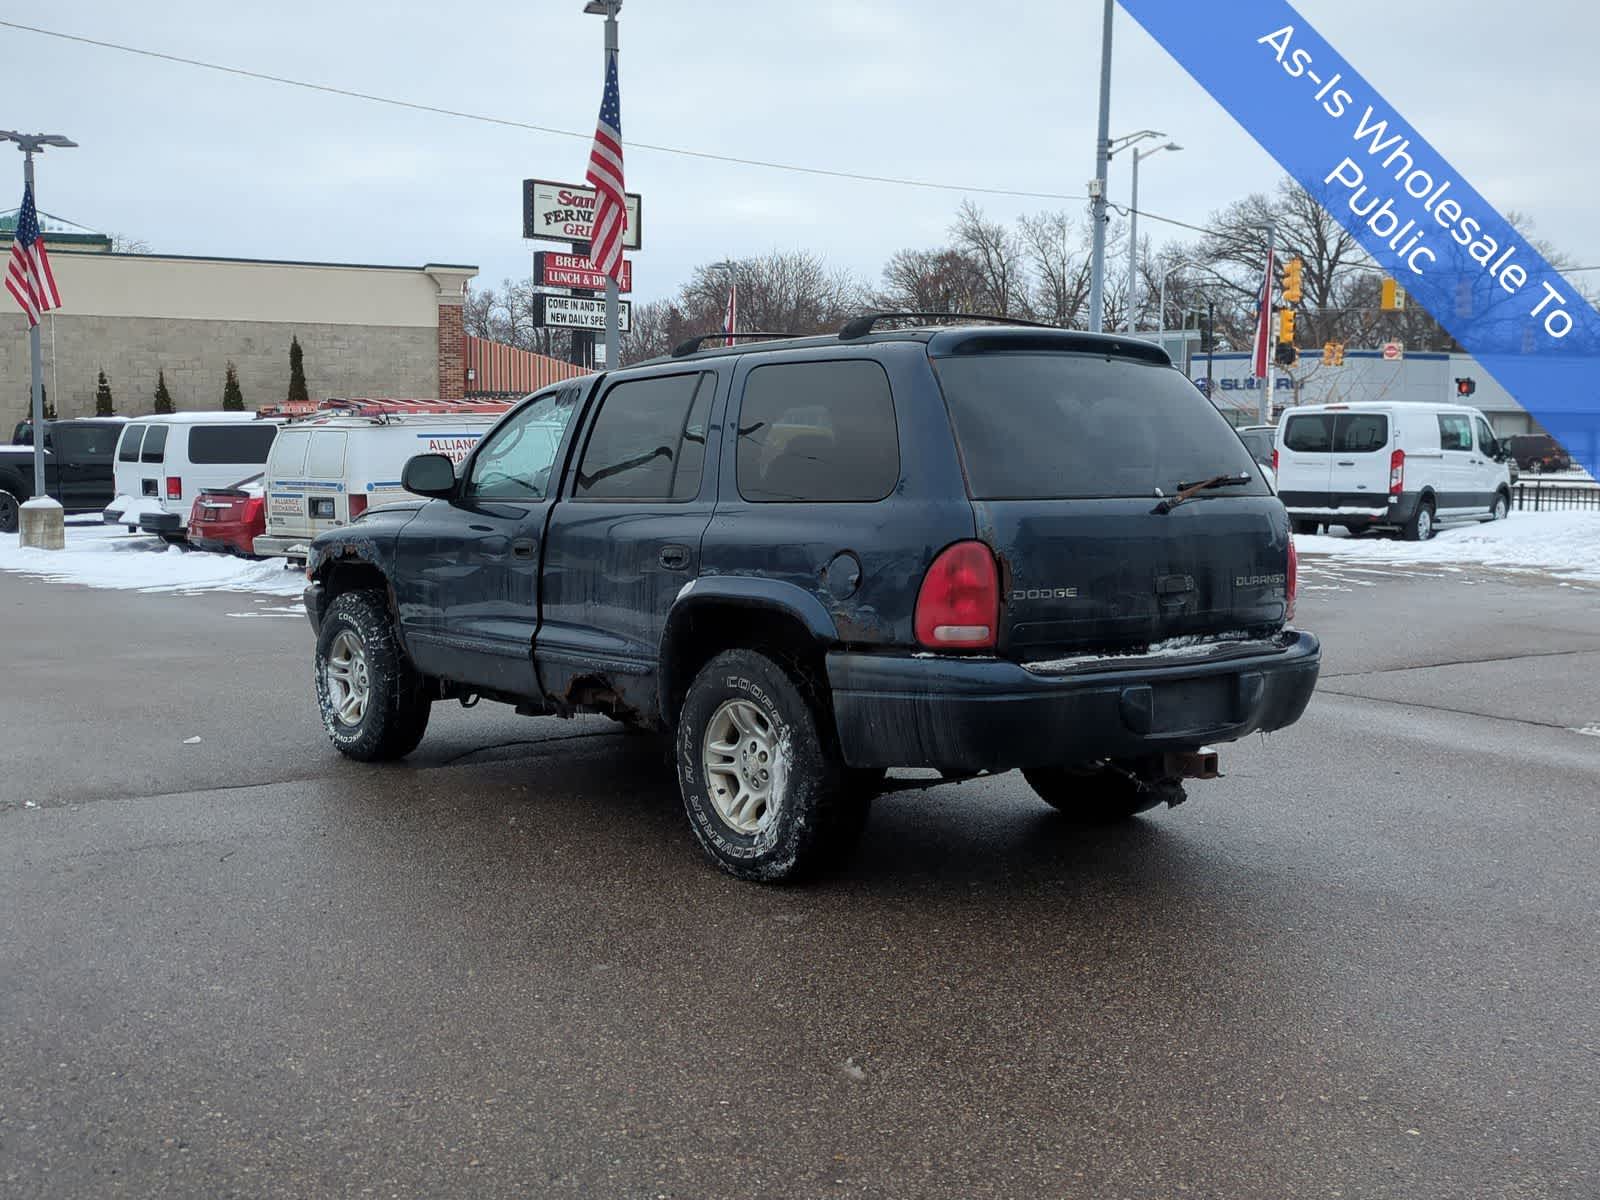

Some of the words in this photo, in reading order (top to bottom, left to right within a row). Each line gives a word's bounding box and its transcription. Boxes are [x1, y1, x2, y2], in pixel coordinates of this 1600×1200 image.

[544, 209, 593, 225] FERND
[563, 223, 592, 237] GRI
[555, 255, 597, 271] BREAK
[549, 271, 580, 285] LUNCH
[583, 275, 590, 286] &
[548, 299, 569, 311] COME
[570, 300, 579, 312] IN
[580, 301, 595, 313] AND
[550, 312, 568, 324] NEW
[568, 314, 589, 326] DAILY
[429, 439, 478, 451] ALLIANC
[1236, 574, 1286, 587] DURANGO
[1013, 587, 1078, 600] DODGE
